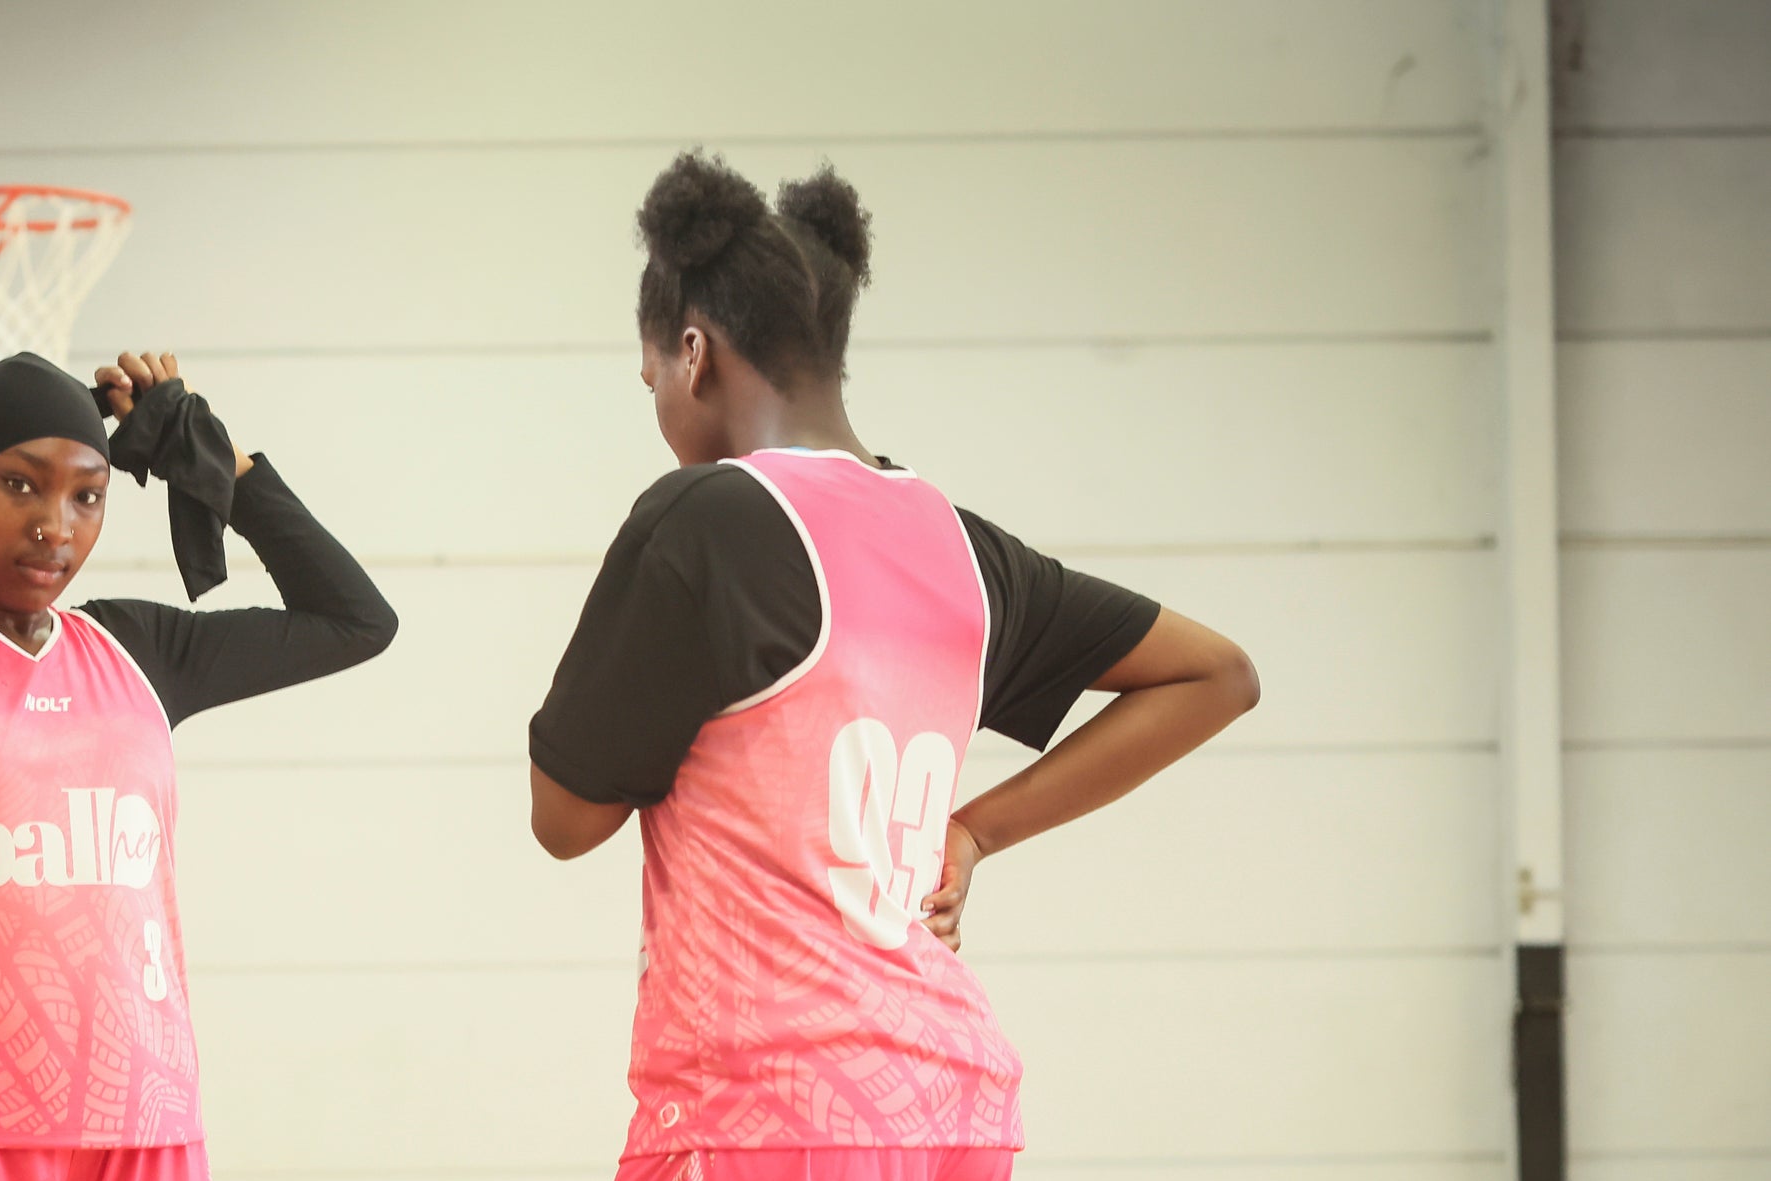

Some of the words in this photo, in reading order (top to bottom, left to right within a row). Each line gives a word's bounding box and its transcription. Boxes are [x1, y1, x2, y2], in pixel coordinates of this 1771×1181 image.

[24, 692, 72, 712] NOLT
[828, 718, 956, 950] 93
[144, 919, 167, 1002] 3
